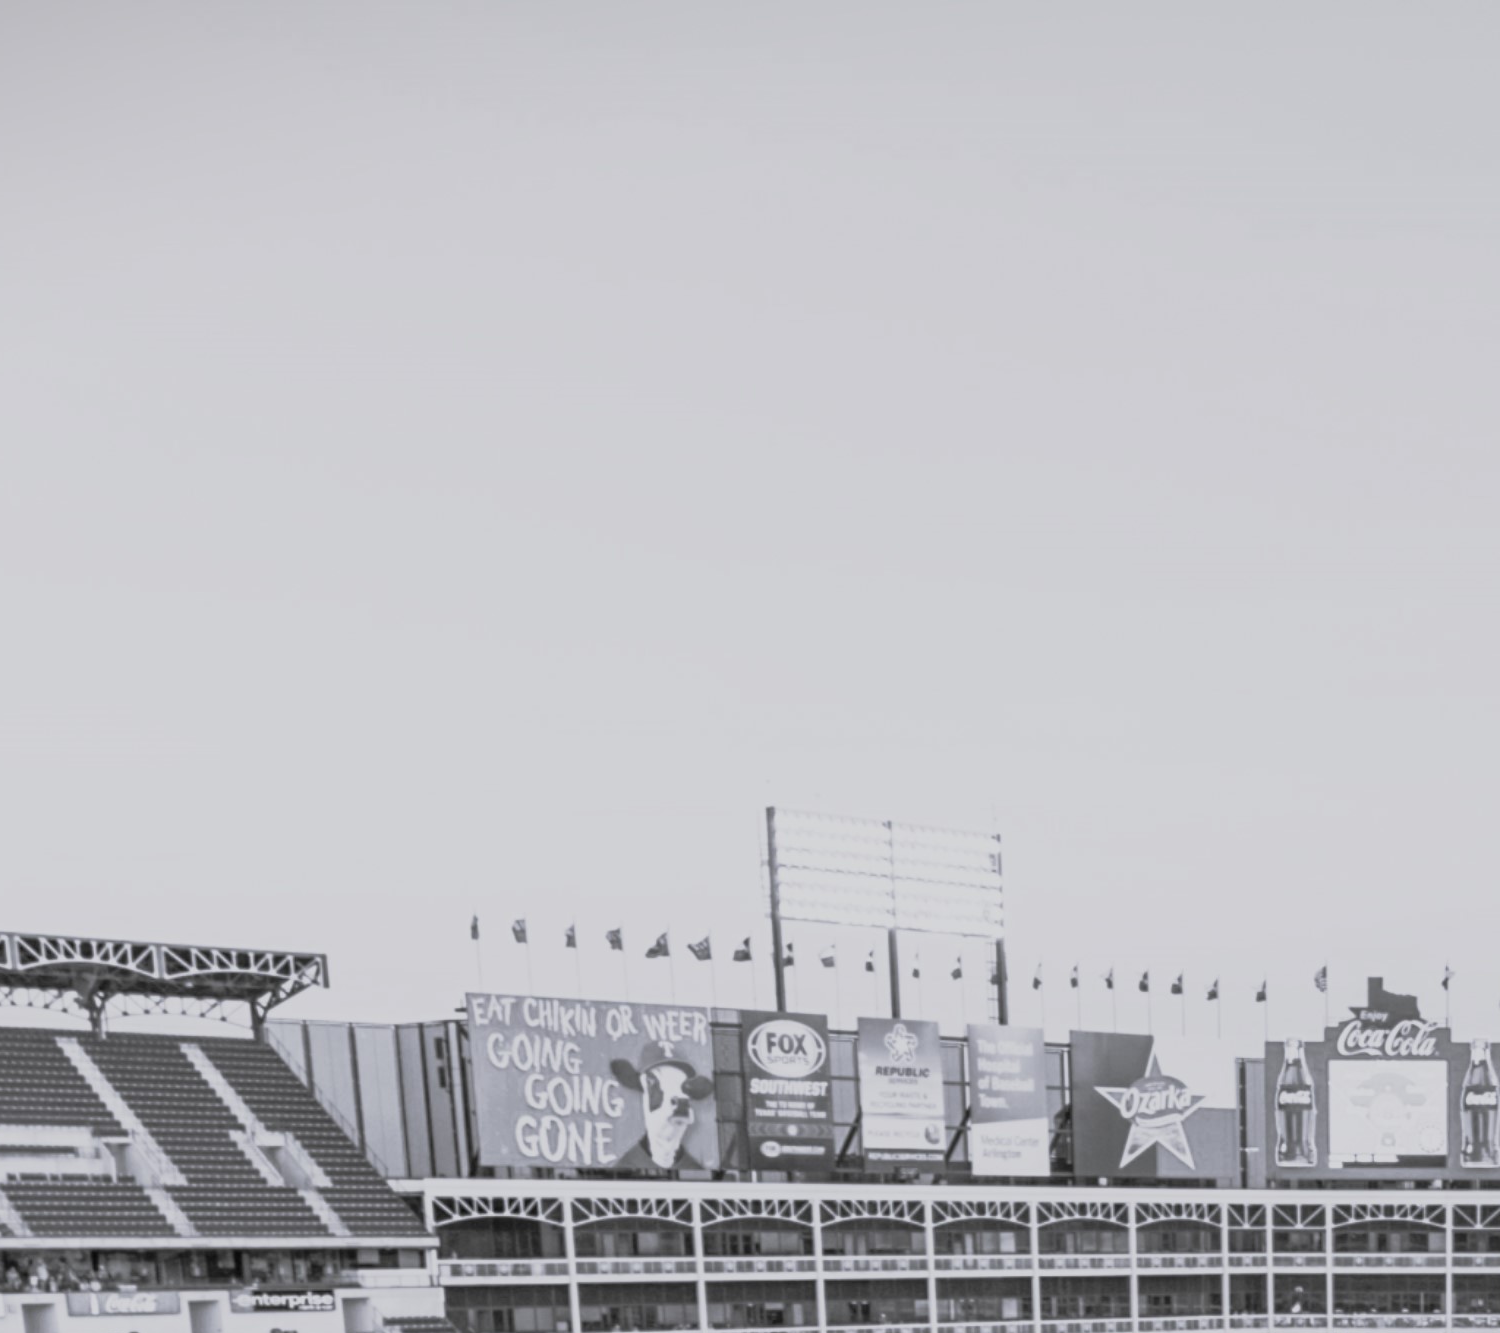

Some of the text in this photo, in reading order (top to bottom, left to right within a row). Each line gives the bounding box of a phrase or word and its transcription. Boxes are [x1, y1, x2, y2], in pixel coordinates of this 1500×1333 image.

[471, 998, 516, 1026] EAT
[522, 998, 597, 1038] CHIKIN
[606, 1005, 638, 1041] OR
[1359, 1010, 1389, 1022] Enjoy
[766, 1032, 808, 1056] FOX
[1337, 1019, 1439, 1057] Coca-Cola
[486, 1032, 583, 1075] GOING
[766, 1055, 810, 1066] SPORTS
[875, 1066, 930, 1079] REPUBLIC
[524, 1072, 625, 1118] GOING
[749, 1078, 829, 1097] SOUTHWEST
[1120, 1085, 1192, 1119] Ozarka
[515, 1114, 617, 1166] GONE
[235, 1291, 334, 1309] enterprise
